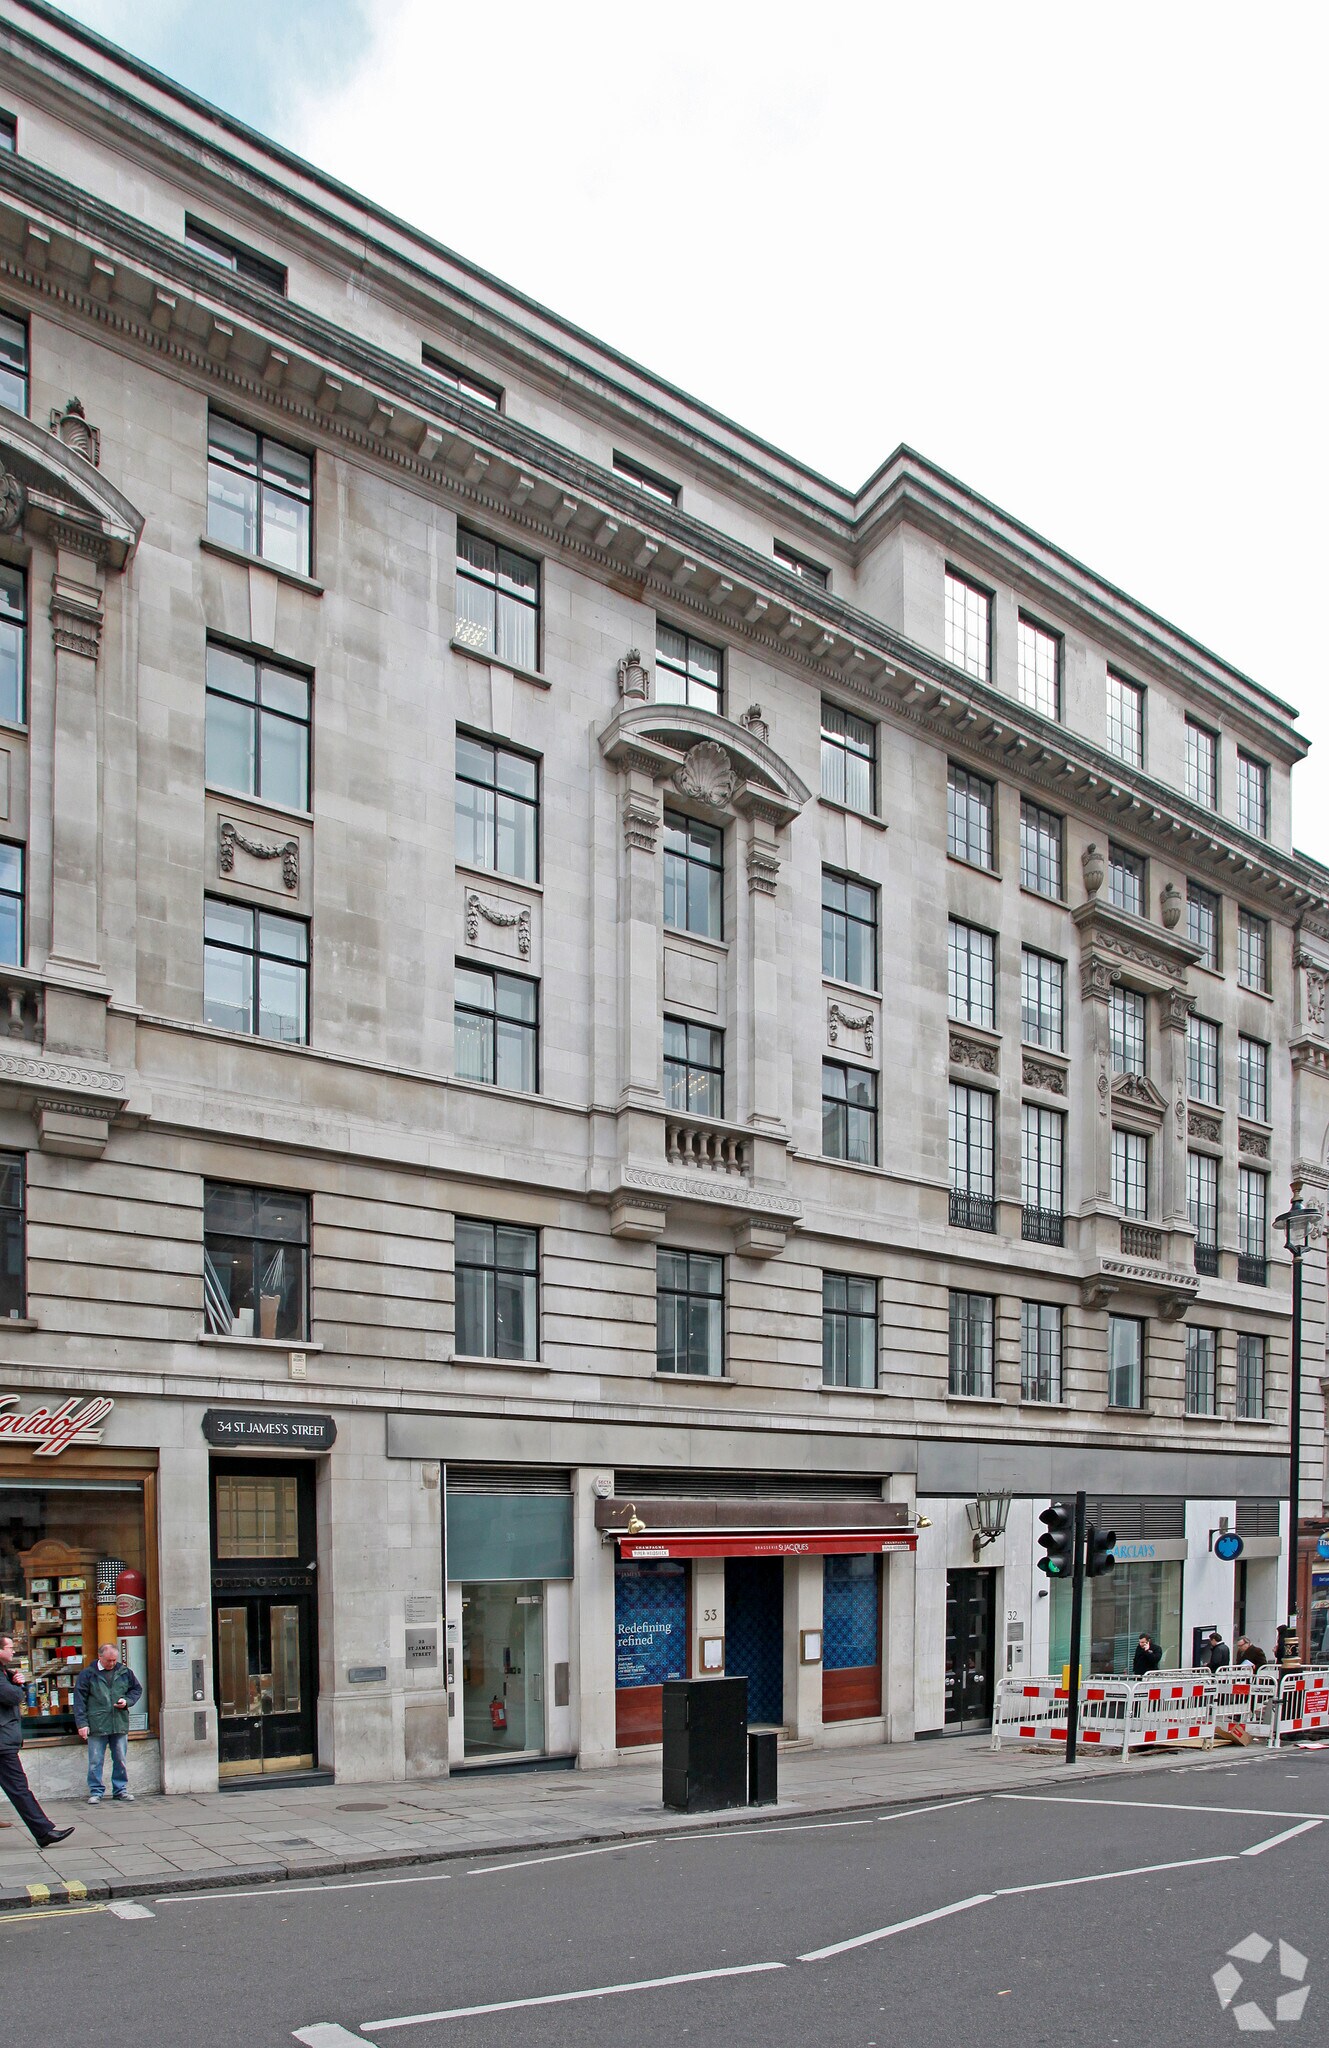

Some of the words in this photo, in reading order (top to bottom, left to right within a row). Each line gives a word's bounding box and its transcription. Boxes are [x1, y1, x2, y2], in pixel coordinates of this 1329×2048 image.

[217, 1421, 231, 1433] 34
[291, 1425, 325, 1436] STREET
[704, 1608, 717, 1622] 33
[1007, 1610, 1018, 1621] 32
[617, 1621, 672, 1635] Redefining
[617, 1633, 654, 1647] refined
